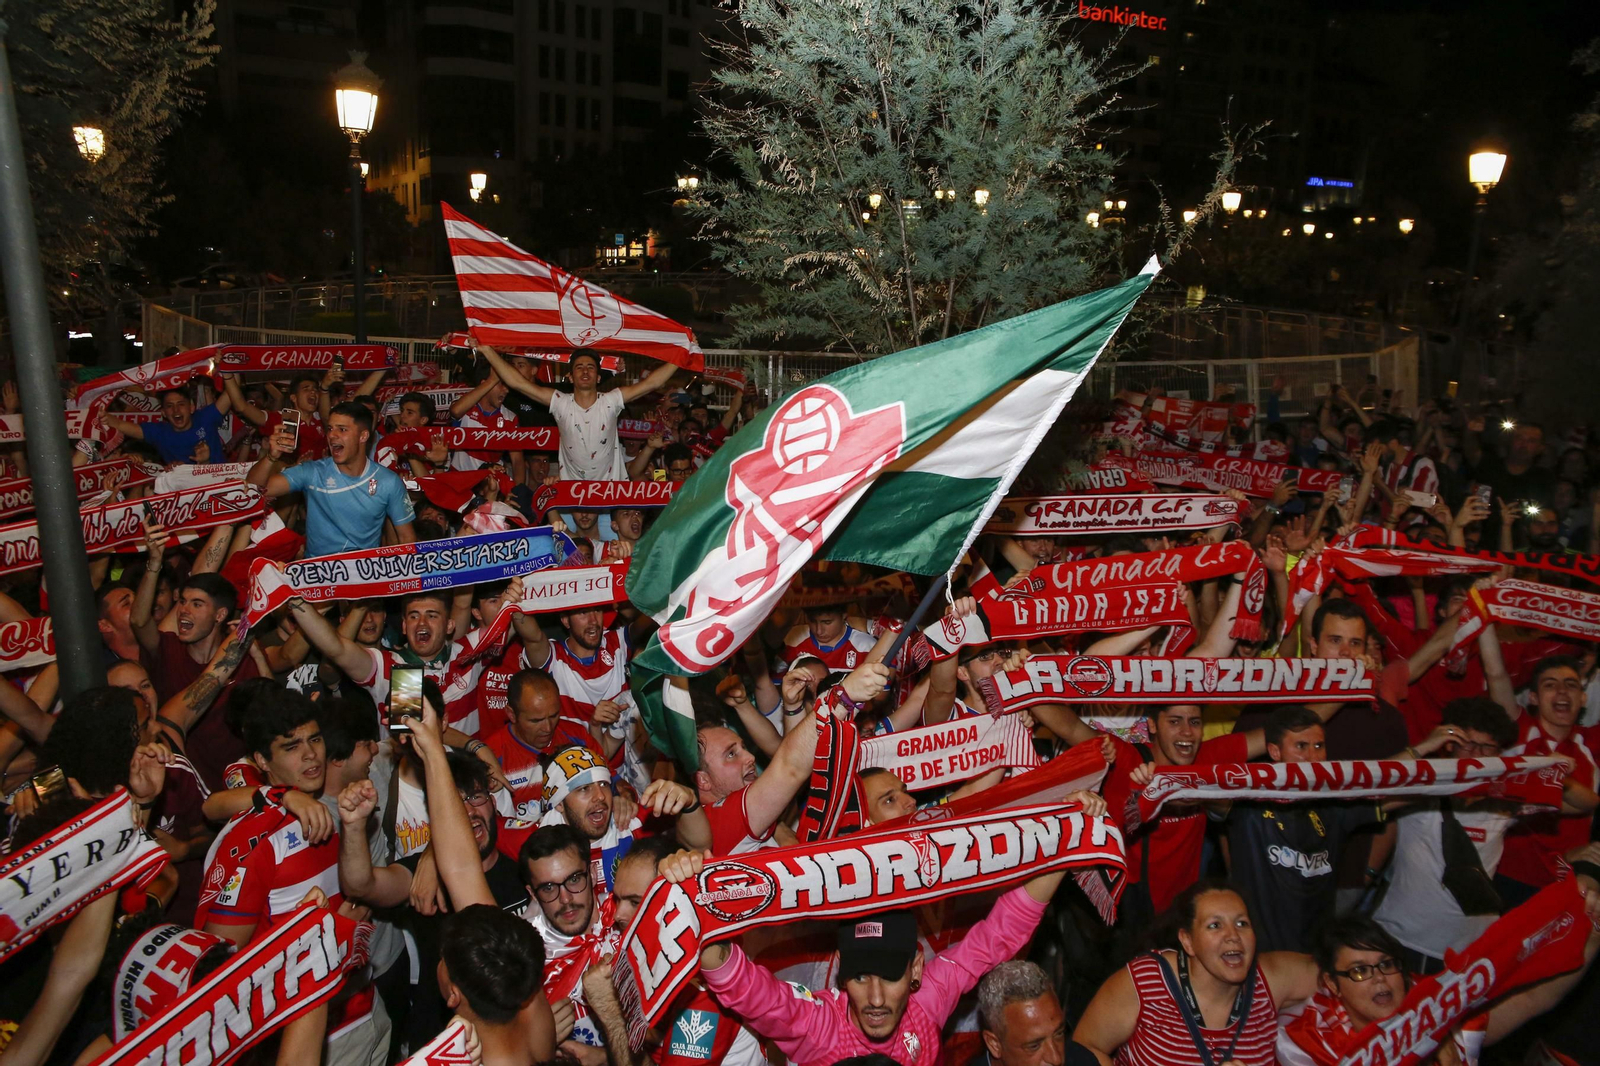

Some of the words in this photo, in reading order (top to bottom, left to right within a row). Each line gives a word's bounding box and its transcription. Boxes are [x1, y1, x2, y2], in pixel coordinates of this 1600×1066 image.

[260, 350, 346, 370] GRANAD
[347, 350, 374, 364] C.F.
[472, 427, 551, 448] Granada
[78, 472, 95, 492] de
[569, 481, 674, 505] GRANADA
[83, 514, 110, 545] lub
[115, 506, 140, 538] de
[1024, 498, 1144, 526] GRANADA
[1151, 498, 1193, 514] C.F.
[356, 537, 530, 580] UNIVERSITARIA
[1052, 550, 1182, 592] Granada
[324, 585, 338, 598] CF
[387, 579, 420, 594] SIEMPRE
[422, 576, 453, 588] AMIGOS
[502, 554, 555, 576] MALAGUISTA
[1013, 592, 1110, 626] GRADA
[1122, 588, 1180, 616] 1931
[993, 660, 1065, 701] LA
[1111, 657, 1373, 694] HORIZONTAL
[896, 724, 978, 758] GRANADA
[920, 758, 945, 780] DE
[949, 742, 1007, 774] FÚTBOL
[1214, 757, 1439, 792] GRANADA
[517, 798, 548, 816] SOL
[395, 816, 433, 855] THR
[1268, 844, 1330, 871] SOLVER
[142, 925, 184, 957] ENDO
[627, 884, 701, 1001] LA
[856, 924, 882, 935] IMAGINE
[120, 960, 145, 1032] HISTORIA
[671, 1042, 687, 1051] CAJA
[687, 1045, 710, 1055] RURAL
[672, 1049, 706, 1060] GRANADA
